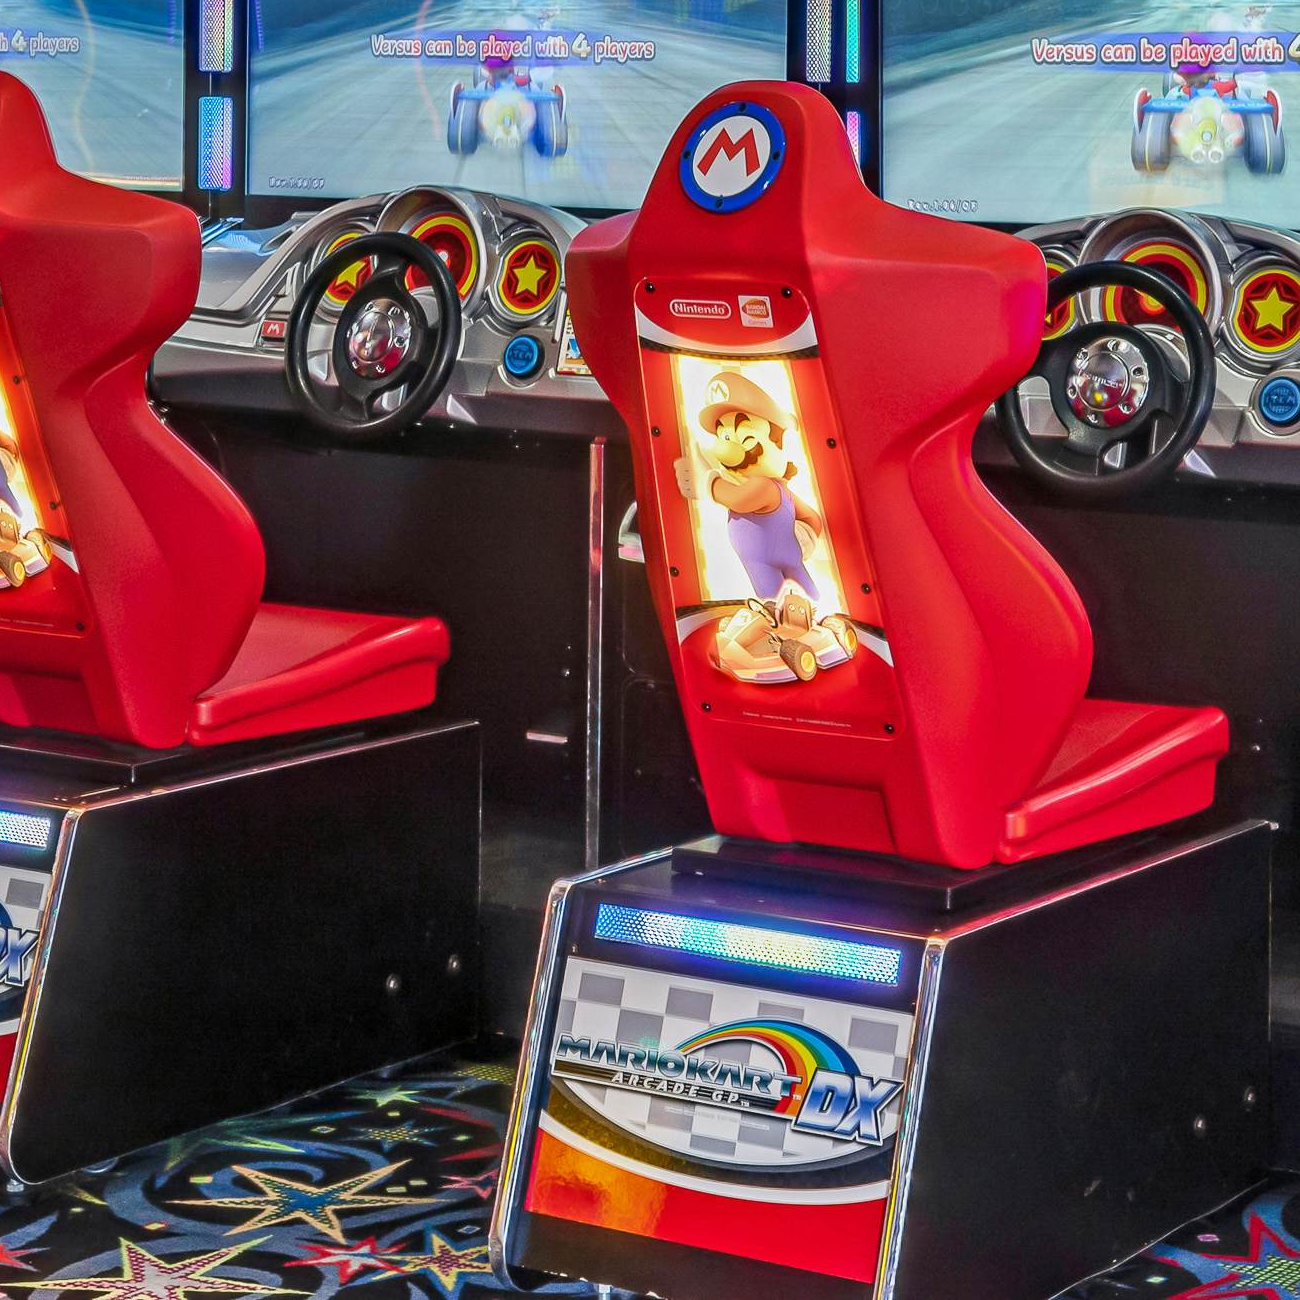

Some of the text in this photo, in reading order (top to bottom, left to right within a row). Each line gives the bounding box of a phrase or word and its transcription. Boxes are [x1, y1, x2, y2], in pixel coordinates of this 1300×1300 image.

[11, 30, 28, 51] 4
[30, 33, 80, 55] players
[370, 32, 656, 62] Versus can be played with 4 players
[1031, 37, 1096, 64] Versus
[1100, 42, 1135, 64] can
[1140, 38, 1166, 64] be
[1170, 38, 1237, 68] played
[1241, 39, 1284, 64] with
[695, 126, 761, 178] M
[673, 303, 726, 316] Nintendo
[611, 1071, 699, 1099] ARCADE
[793, 1068, 905, 1145] DX
